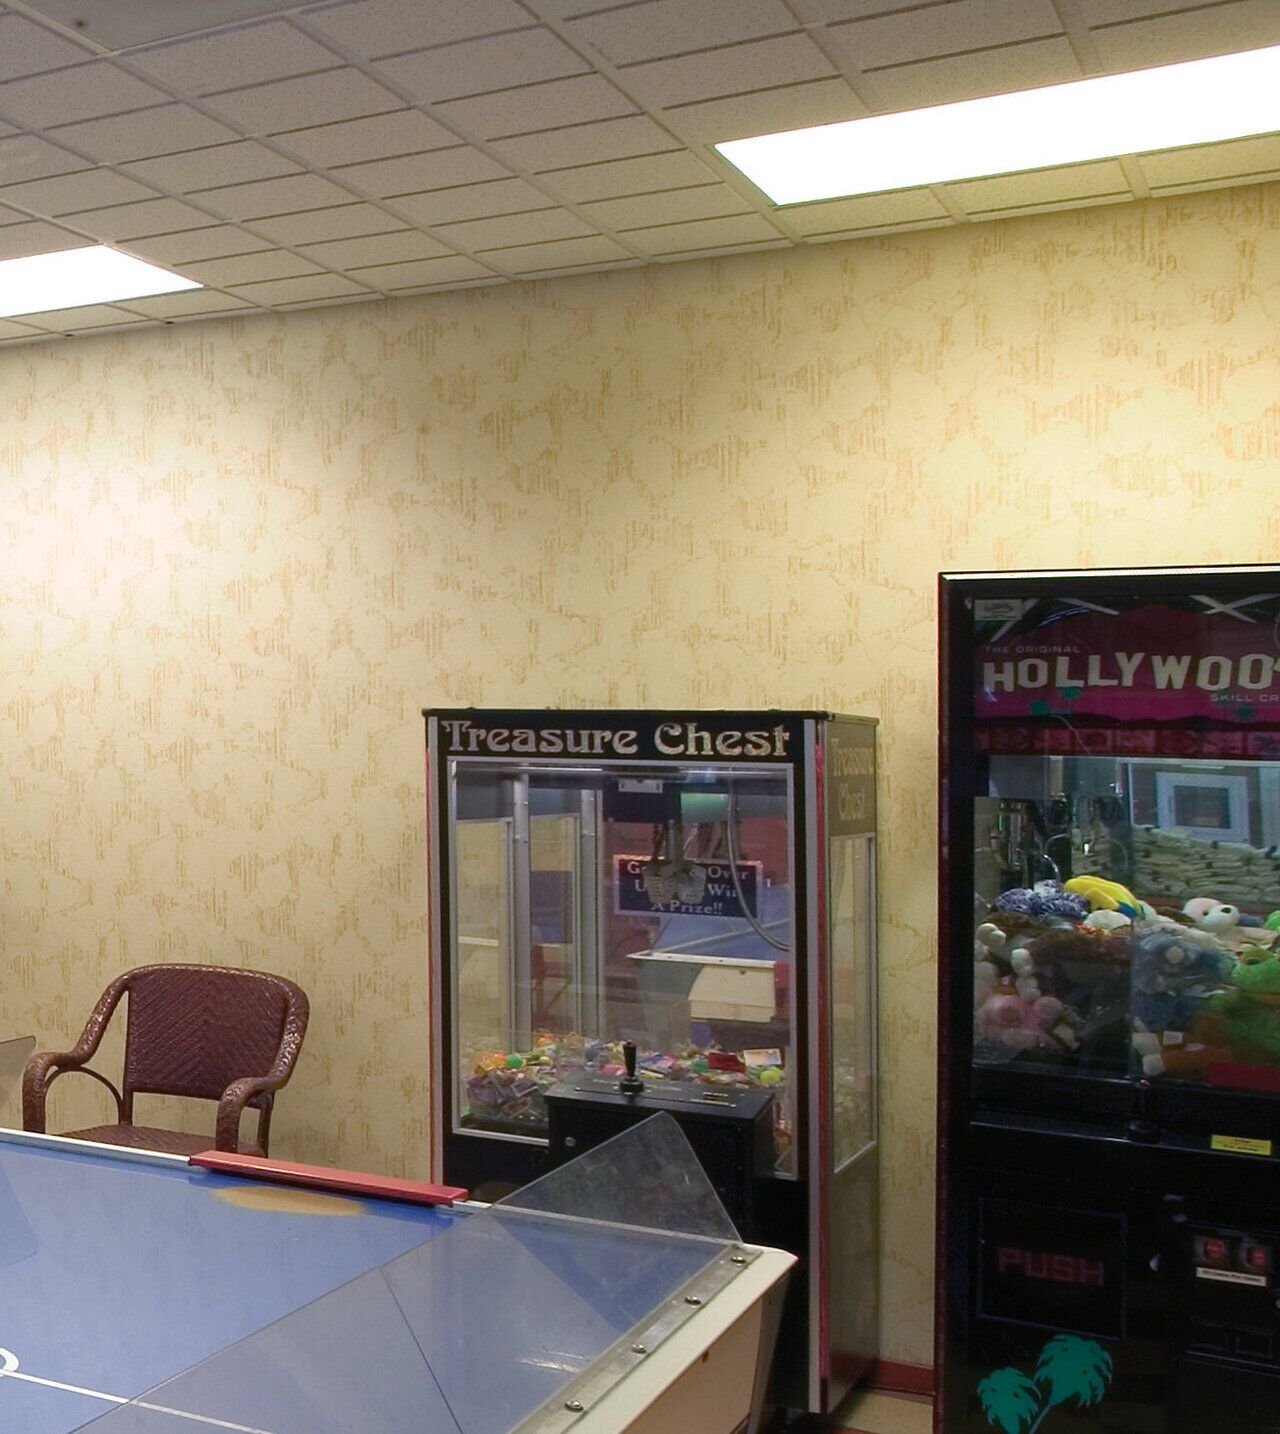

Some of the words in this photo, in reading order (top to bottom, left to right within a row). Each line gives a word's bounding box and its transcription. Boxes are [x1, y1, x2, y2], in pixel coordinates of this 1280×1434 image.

[1016, 645, 1080, 654] ORIGINAL
[984, 652, 1280, 692] HOLLYWOO
[1210, 694, 1253, 703] SKILL
[1258, 694, 1280, 703] CR
[442, 720, 638, 755] Treasure
[653, 722, 790, 756] Chest
[707, 865, 749, 880] Ovr
[669, 900, 724, 916] Prize!!
[997, 1248, 1105, 1287] PUSH
